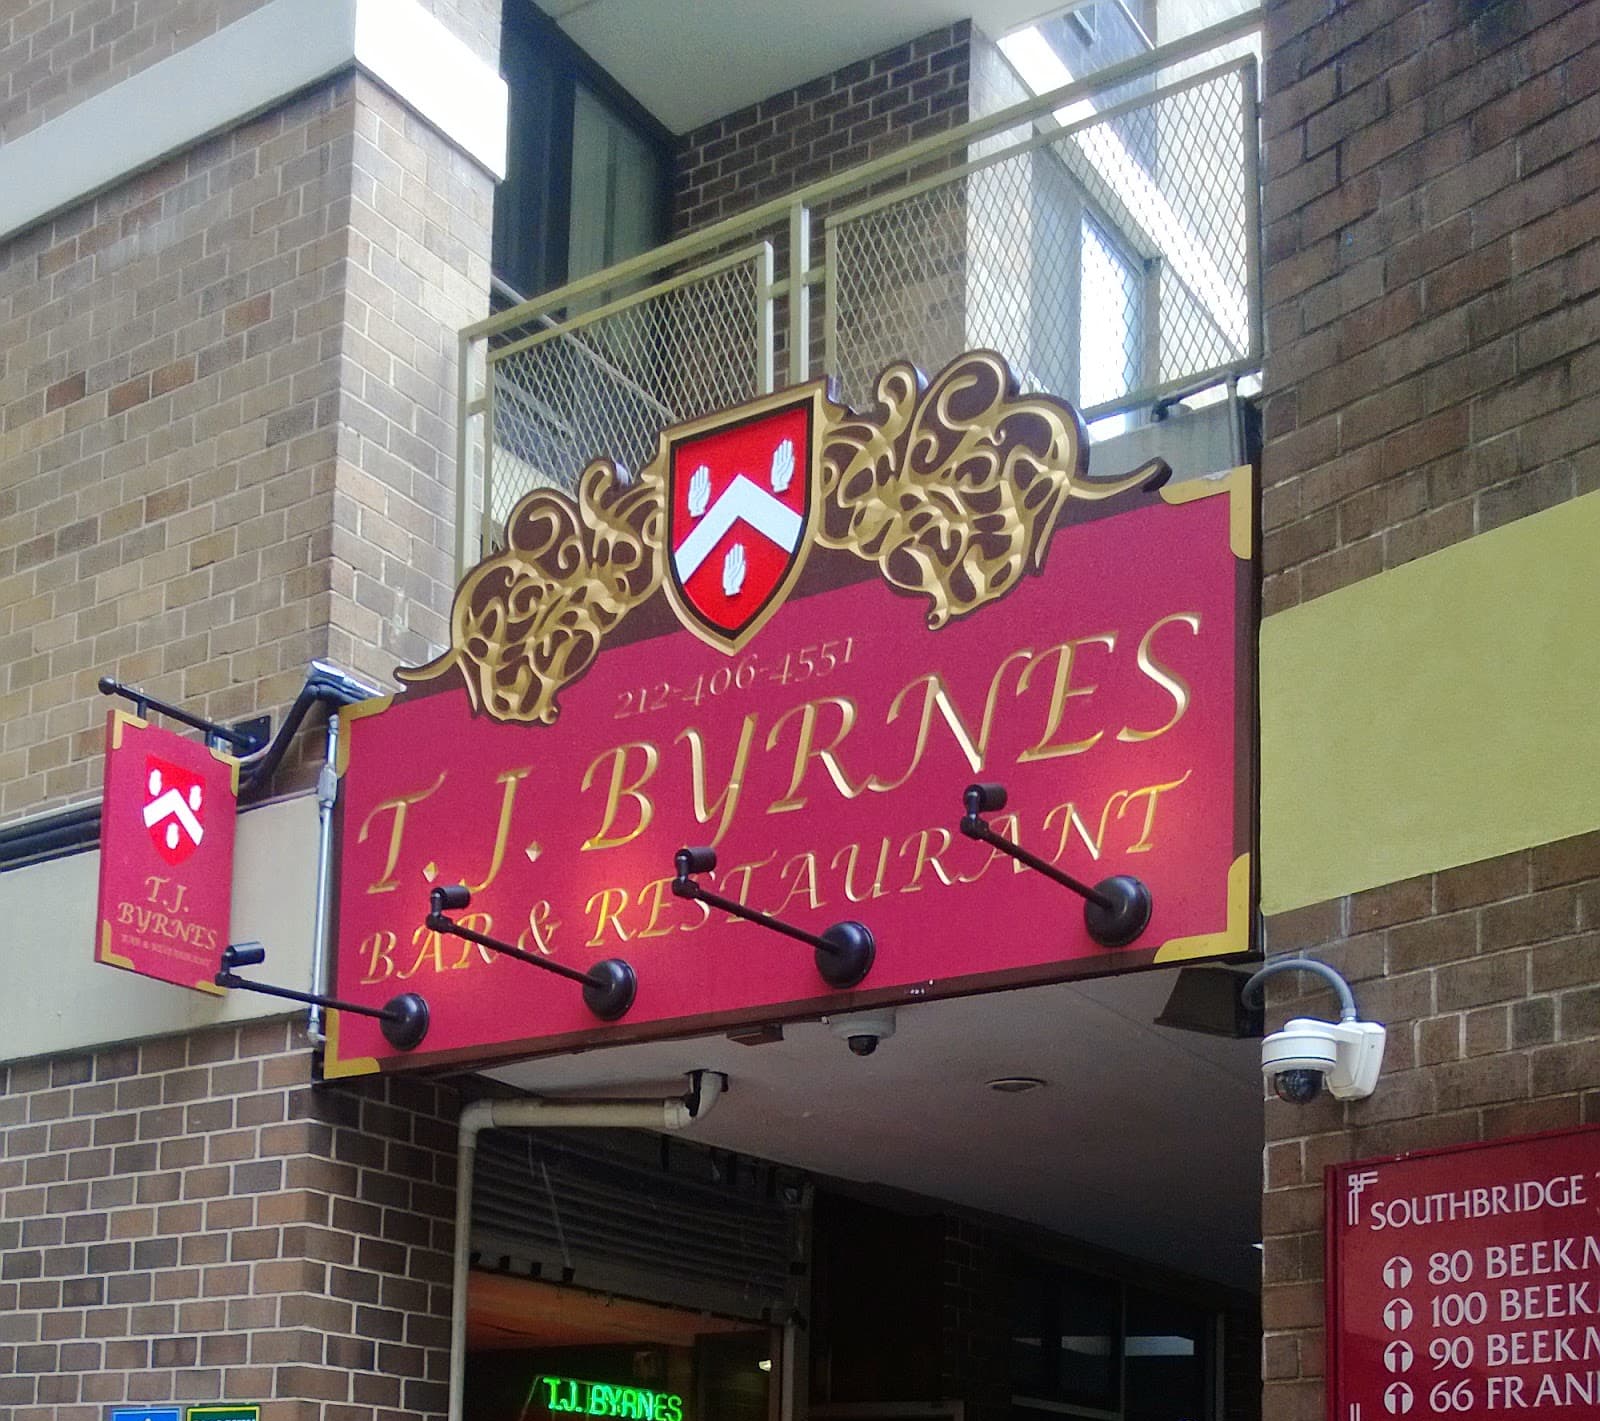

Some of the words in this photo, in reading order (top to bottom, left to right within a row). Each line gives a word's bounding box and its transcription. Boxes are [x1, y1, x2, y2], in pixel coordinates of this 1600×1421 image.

[613, 637, 856, 720] 212-406-4551
[357, 766, 544, 895] T.J.
[580, 610, 1202, 850] BYRNES
[145, 876, 189, 913] T.J.
[359, 911, 498, 985] BAR
[518, 900, 562, 955] &
[584, 768, 1193, 948] RESTAURANT
[118, 902, 217, 950] BYRNES
[1370, 1174, 1587, 1231] SOUTHBRIDGE
[1428, 1250, 1473, 1285] 80
[1431, 1292, 1487, 1328] 100
[1500, 1282, 1600, 1322] BEEK
[1429, 1336, 1473, 1371] 90
[1429, 1378, 1474, 1413] 66
[1487, 1371, 1600, 1410] FRAN
